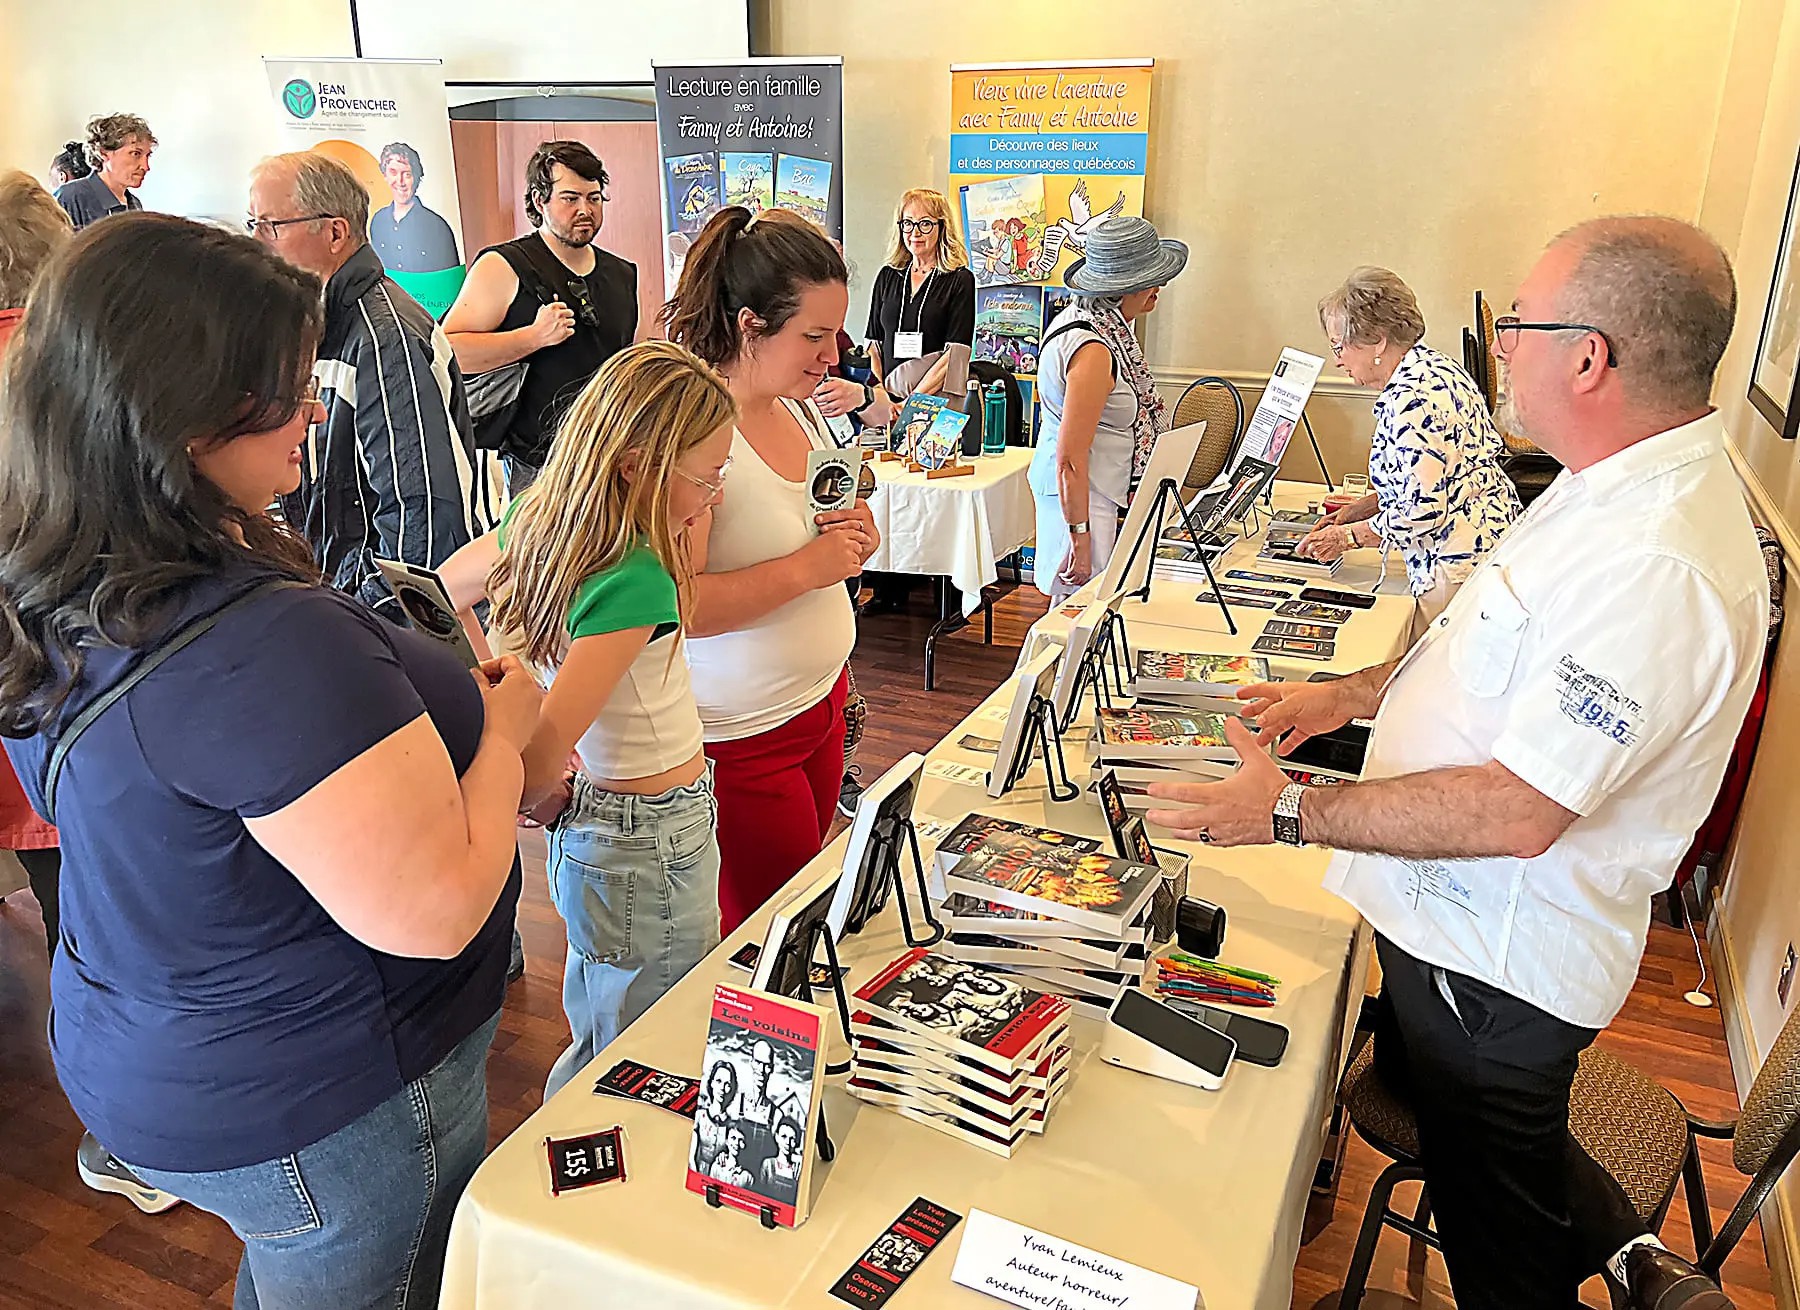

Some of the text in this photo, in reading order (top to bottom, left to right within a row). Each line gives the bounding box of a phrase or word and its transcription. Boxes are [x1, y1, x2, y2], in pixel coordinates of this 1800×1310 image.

[668, 75, 820, 97] Lecture en famille
[973, 73, 1128, 101] Viens vivre l'aventure
[321, 110, 338, 118] Agent
[348, 111, 381, 119] changement
[734, 103, 754, 112] avec
[959, 103, 1139, 134] avec Fanny et Antoine
[678, 114, 815, 144] Fanny et Antoine!
[989, 138, 1099, 151] Découvre des lieux
[957, 157, 1136, 172] et des personnages québécois
[721, 1007, 811, 1044] Les voisins
[564, 1148, 591, 1178] 15$
[912, 1208, 947, 1229] Lemieux
[927, 1204, 948, 1219] Yvan
[1023, 1234, 1124, 1282] Yvan Lemieux
[845, 1283, 868, 1299] vous
[851, 1272, 887, 1295] Oserez-
[1006, 1256, 1130, 1308] Auteur horreur/
